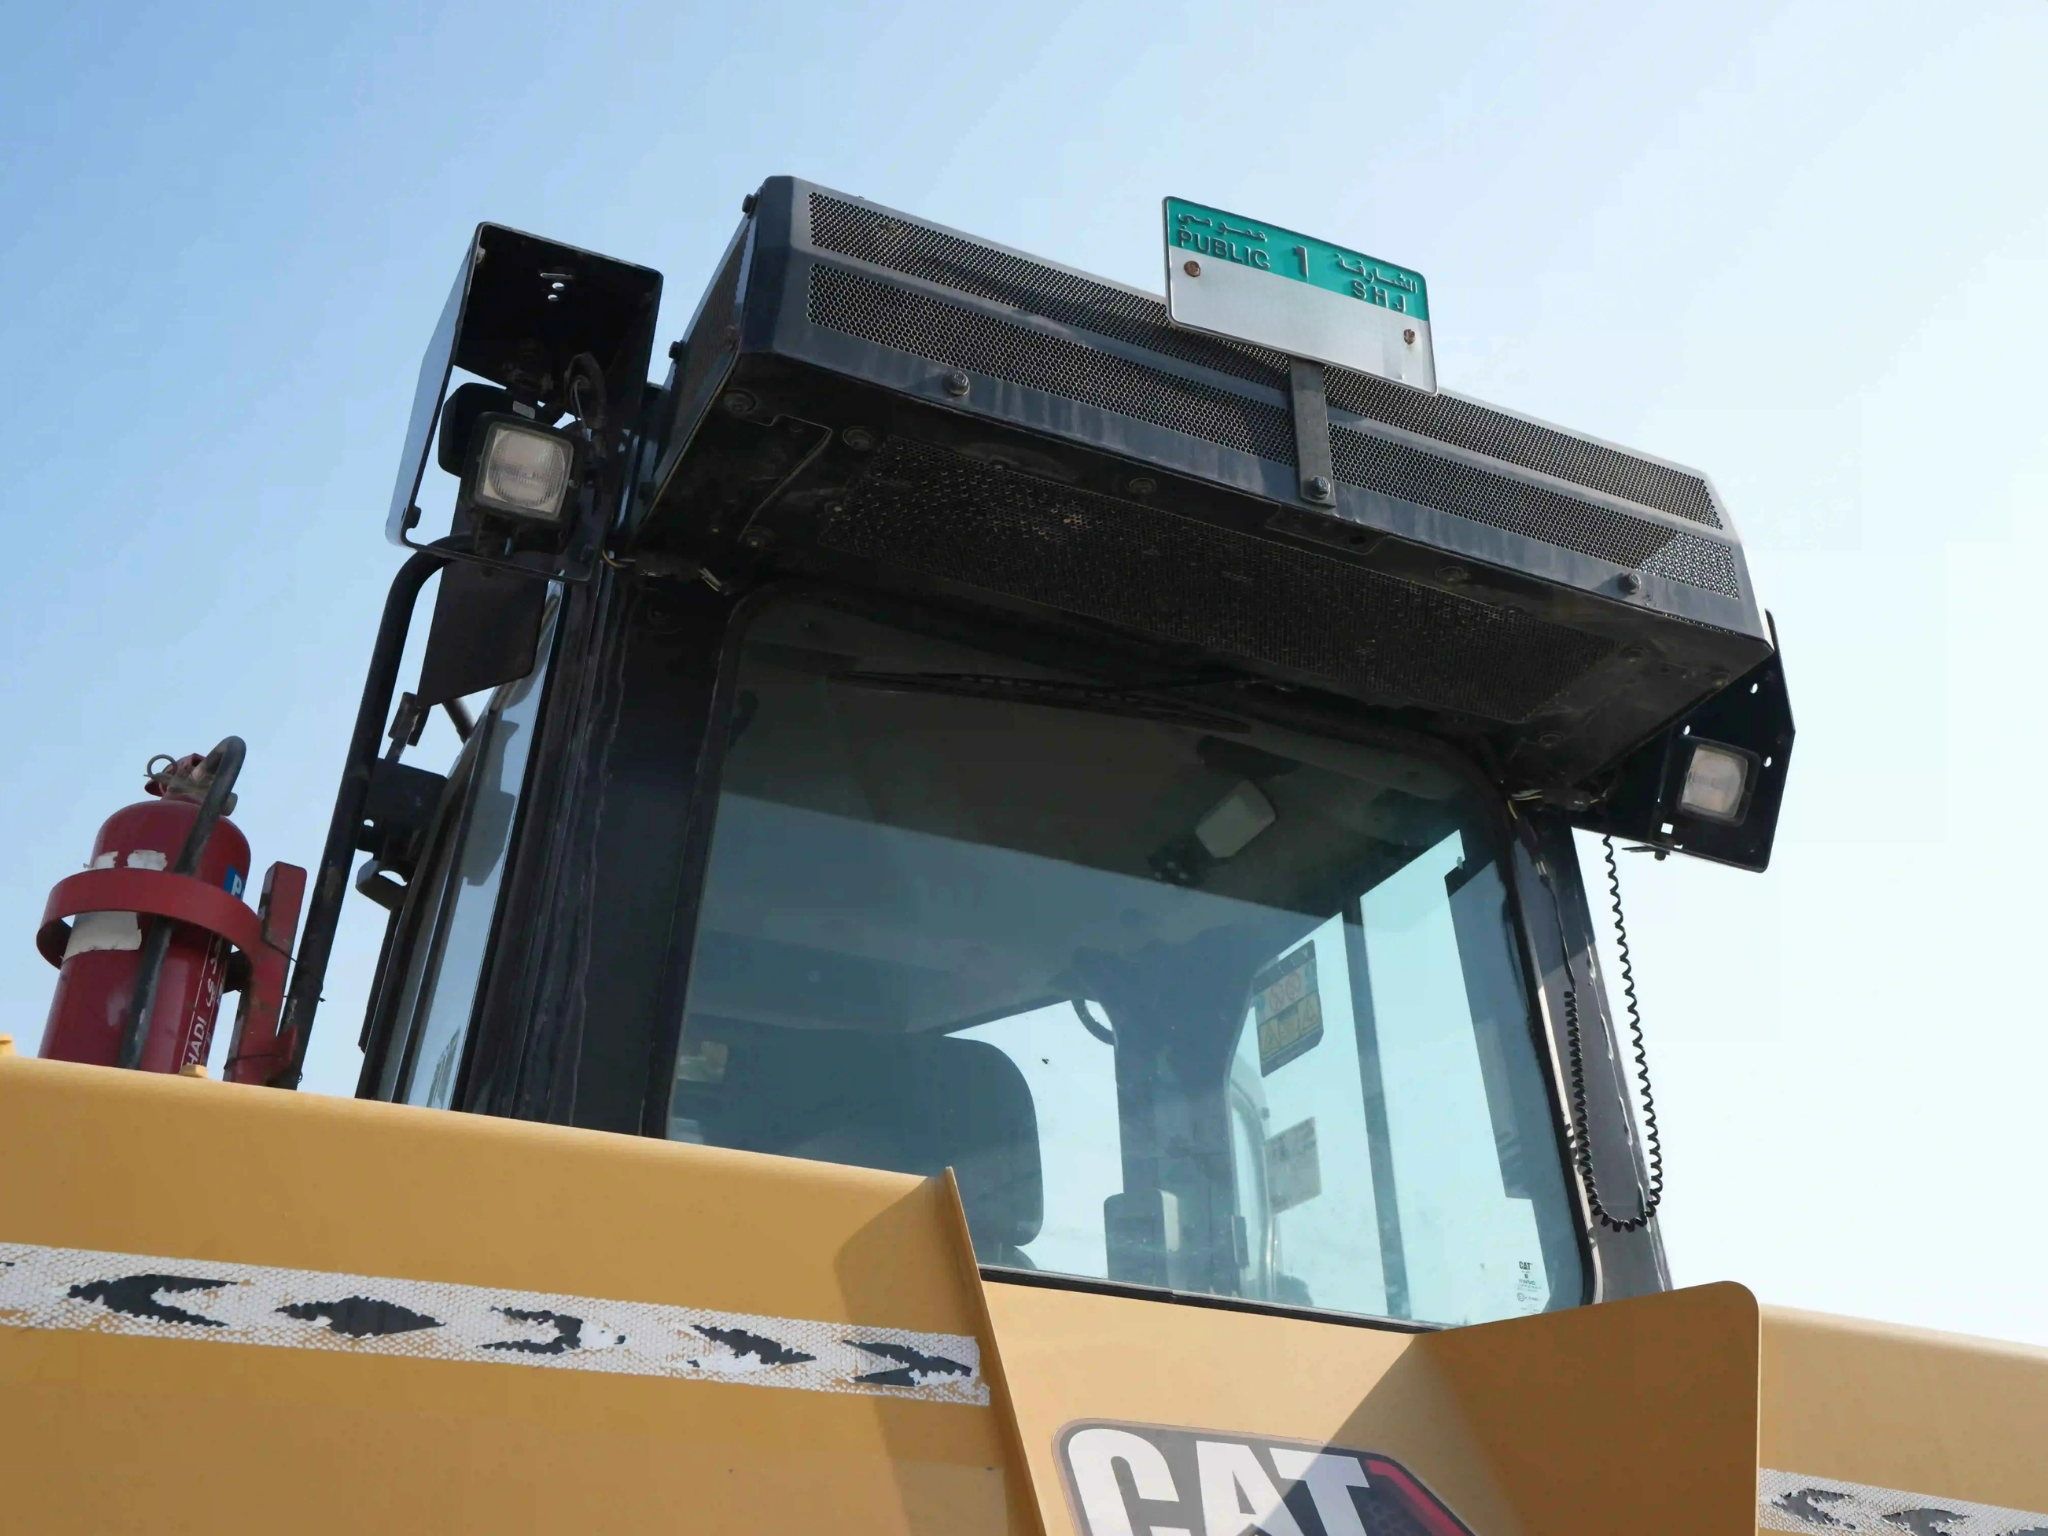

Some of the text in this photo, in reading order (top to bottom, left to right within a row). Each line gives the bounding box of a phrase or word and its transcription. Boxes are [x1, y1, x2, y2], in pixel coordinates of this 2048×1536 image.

[1178, 213, 1418, 294] الشارقة عمومي
[1178, 227, 1407, 313] PUBLIC 1 SHJ
[1518, 1260, 1531, 1271] CAT
[1067, 1428, 1370, 1536] CAT
